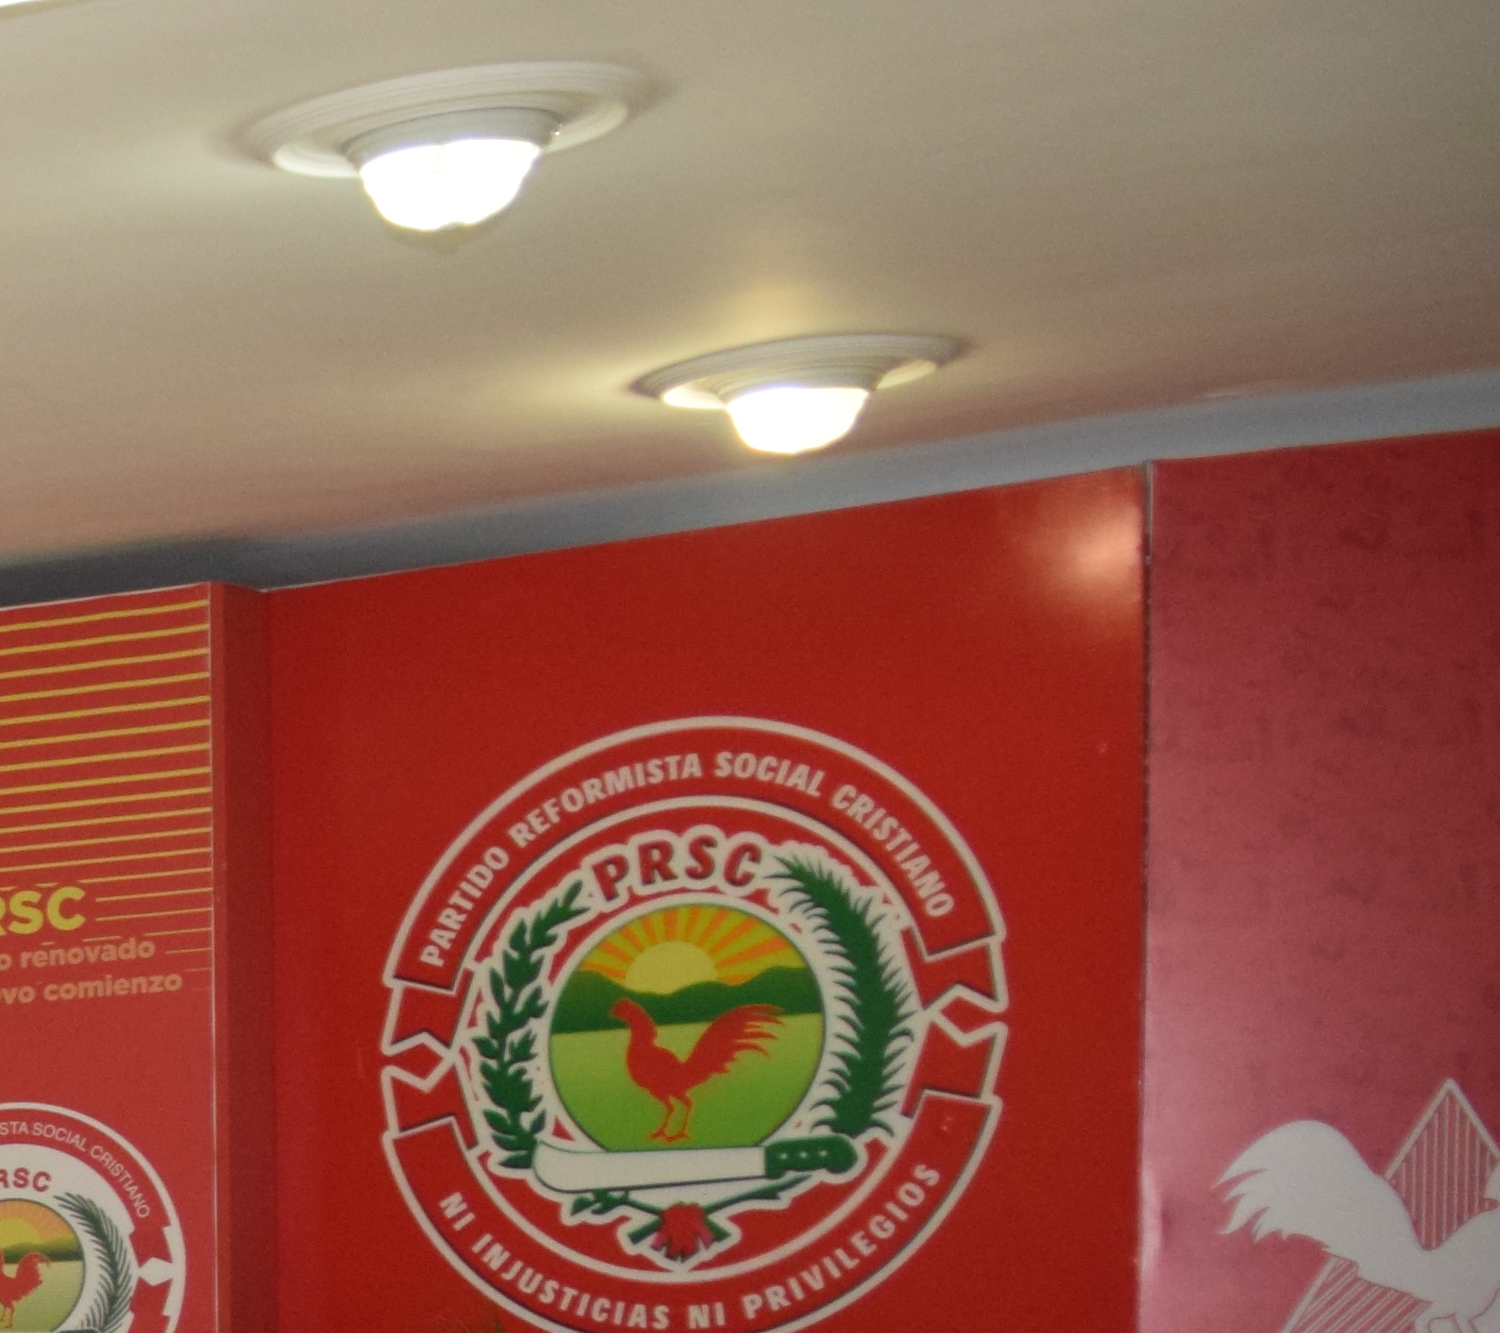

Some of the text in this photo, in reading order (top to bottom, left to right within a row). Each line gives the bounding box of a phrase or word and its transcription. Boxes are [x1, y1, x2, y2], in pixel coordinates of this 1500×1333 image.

[419, 752, 956, 968] PARTIDO REFORMISTA SOCIAL CRISTIANO
[588, 832, 764, 904] PRSC
[19, 937, 156, 968] renovado
[43, 971, 183, 1002] comienzo
[31, 1121, 88, 1153] SOCIAL
[89, 1144, 151, 1219] CRISTIANO
[438, 1162, 941, 1331] NI INJUSTICIAS NI PRIVILEGIOS
